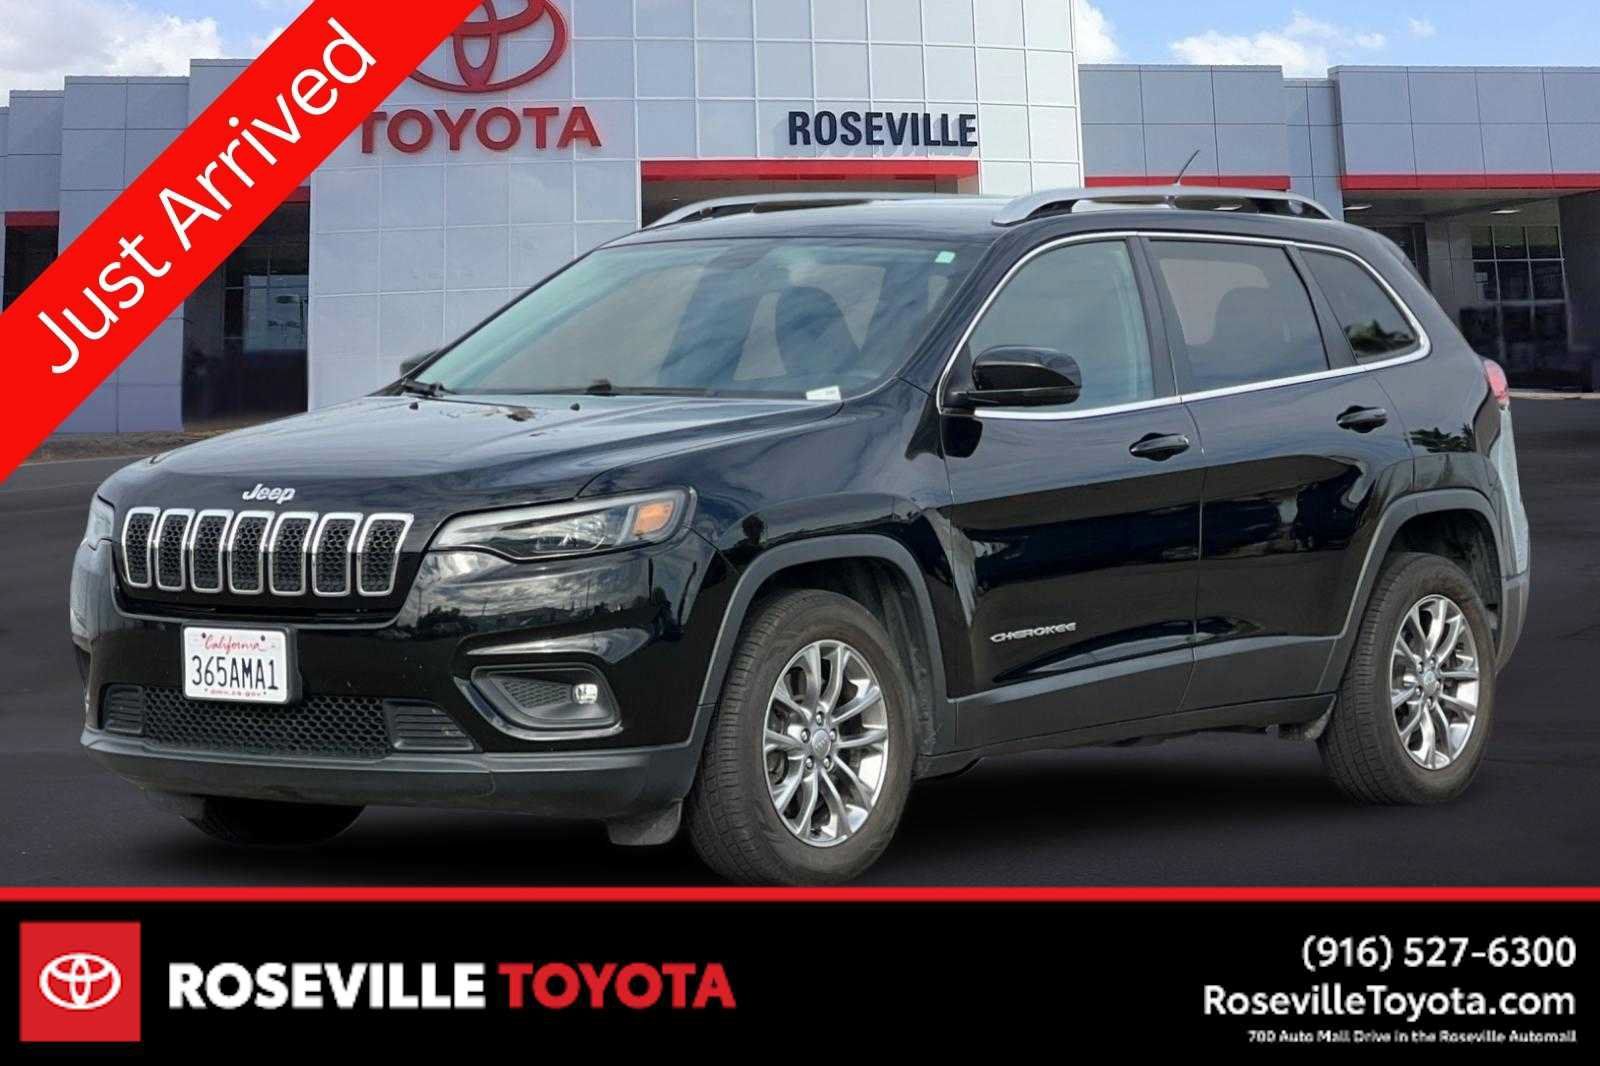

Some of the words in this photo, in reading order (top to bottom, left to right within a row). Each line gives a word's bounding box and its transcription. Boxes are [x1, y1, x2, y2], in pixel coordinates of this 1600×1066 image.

[361, 107, 602, 153] TOYOTA
[788, 111, 978, 147] ROSEVILLE
[242, 483, 296, 505] Jeep
[205, 634, 267, 655] California
[990, 622, 1076, 642] CHEROKEE
[191, 655, 279, 690] 365AMA1
